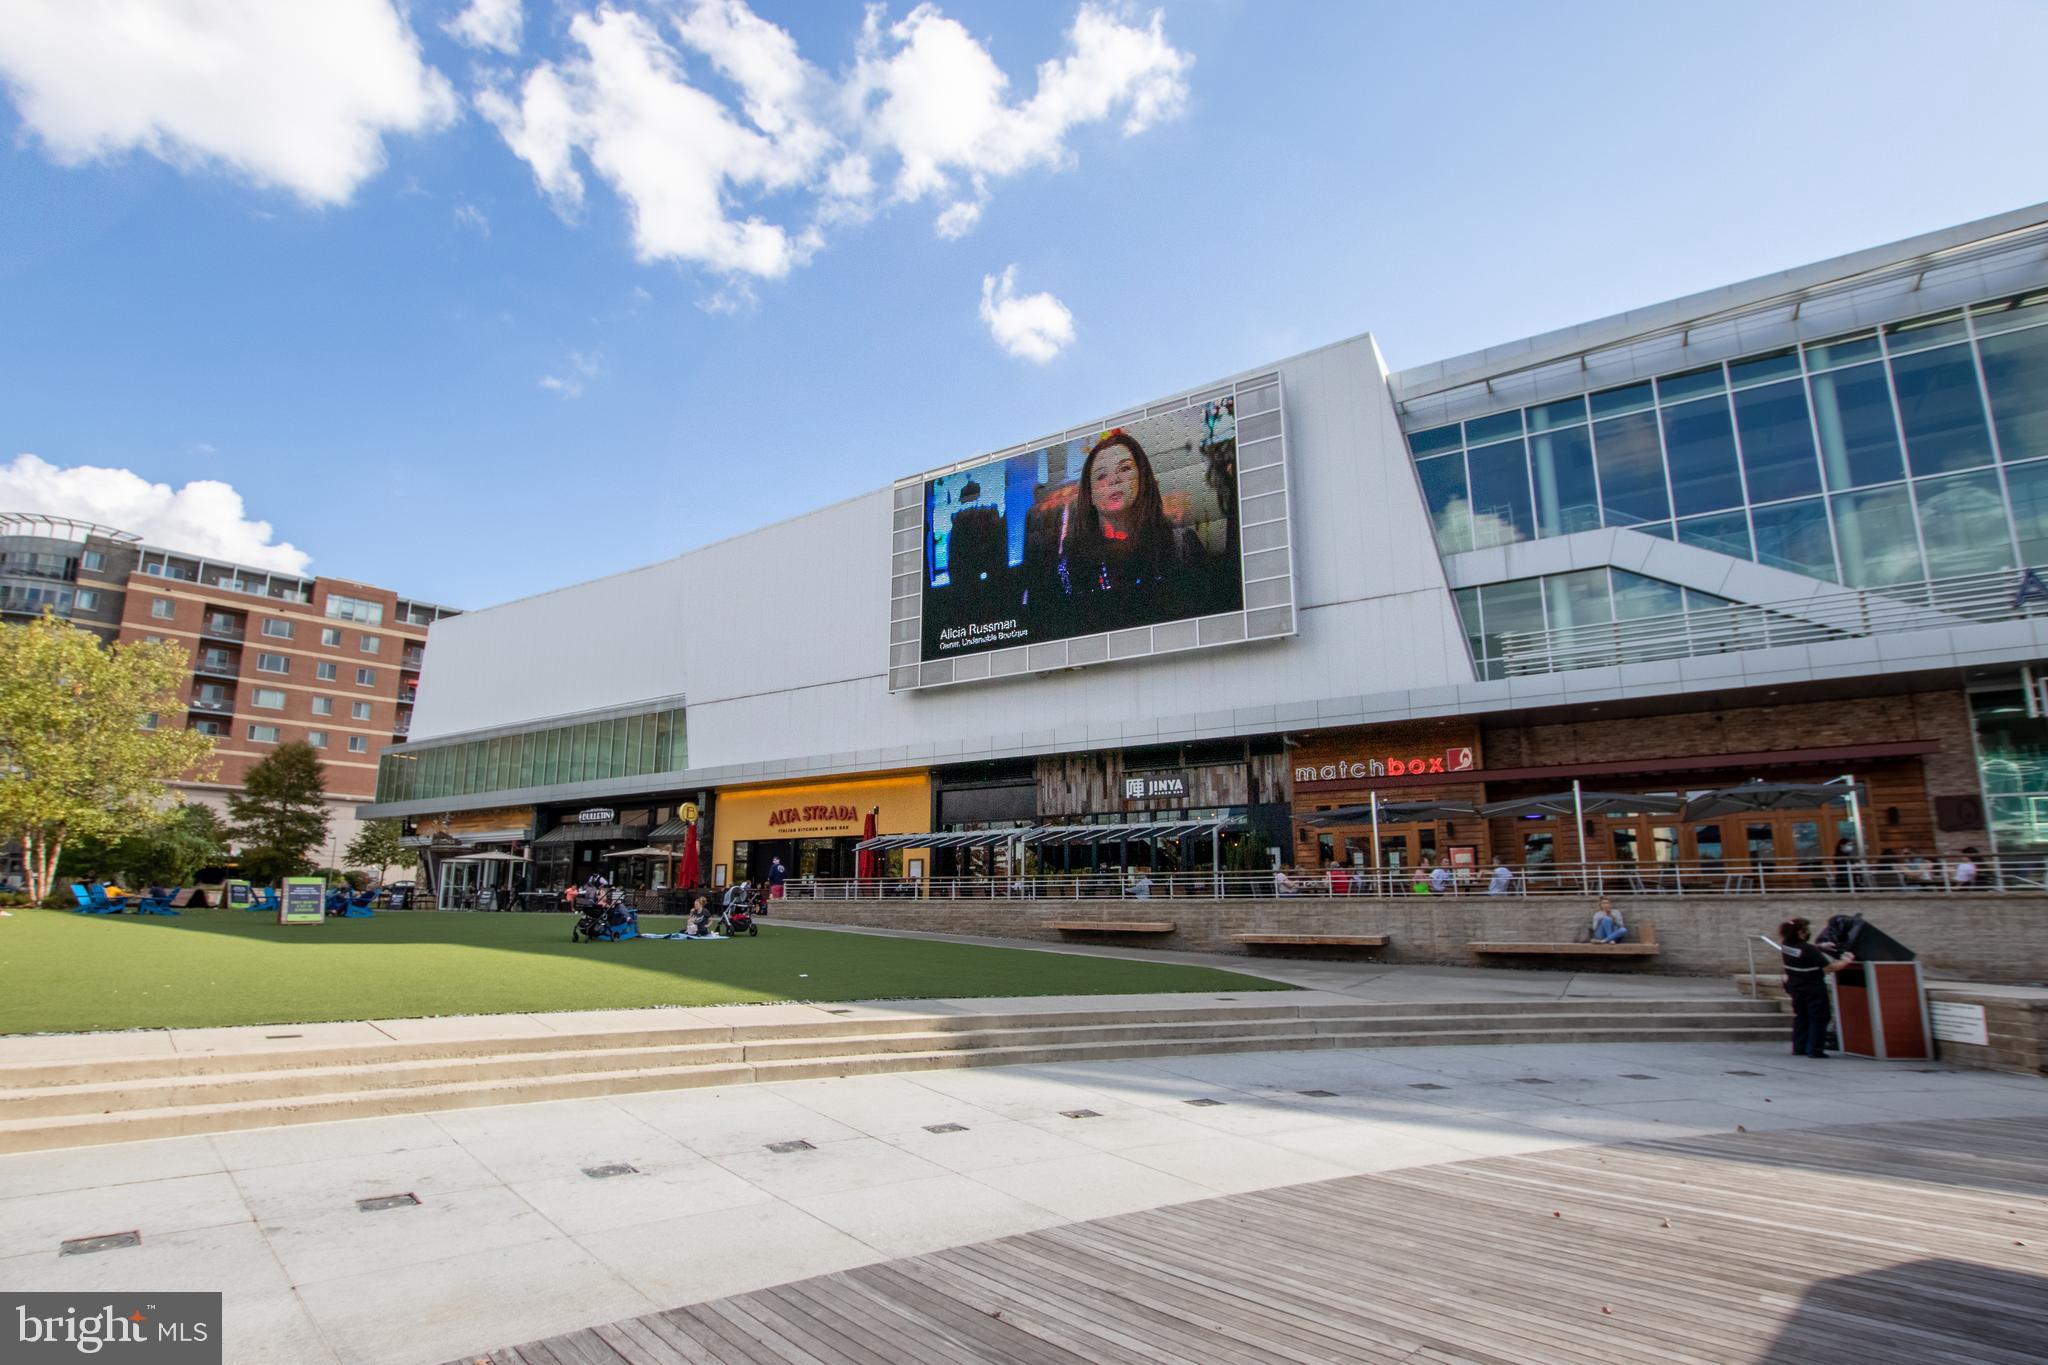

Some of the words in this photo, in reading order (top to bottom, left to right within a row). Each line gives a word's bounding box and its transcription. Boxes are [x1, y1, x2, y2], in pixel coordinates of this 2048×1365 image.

[940, 627, 966, 640] Alicia
[969, 620, 1016, 635] Russman
[1295, 757, 1445, 782] matchbox
[1149, 778, 1183, 796] JINYA
[582, 811, 611, 821] BULLETIN
[769, 808, 801, 826] ALTA
[802, 805, 858, 822] STRADA
